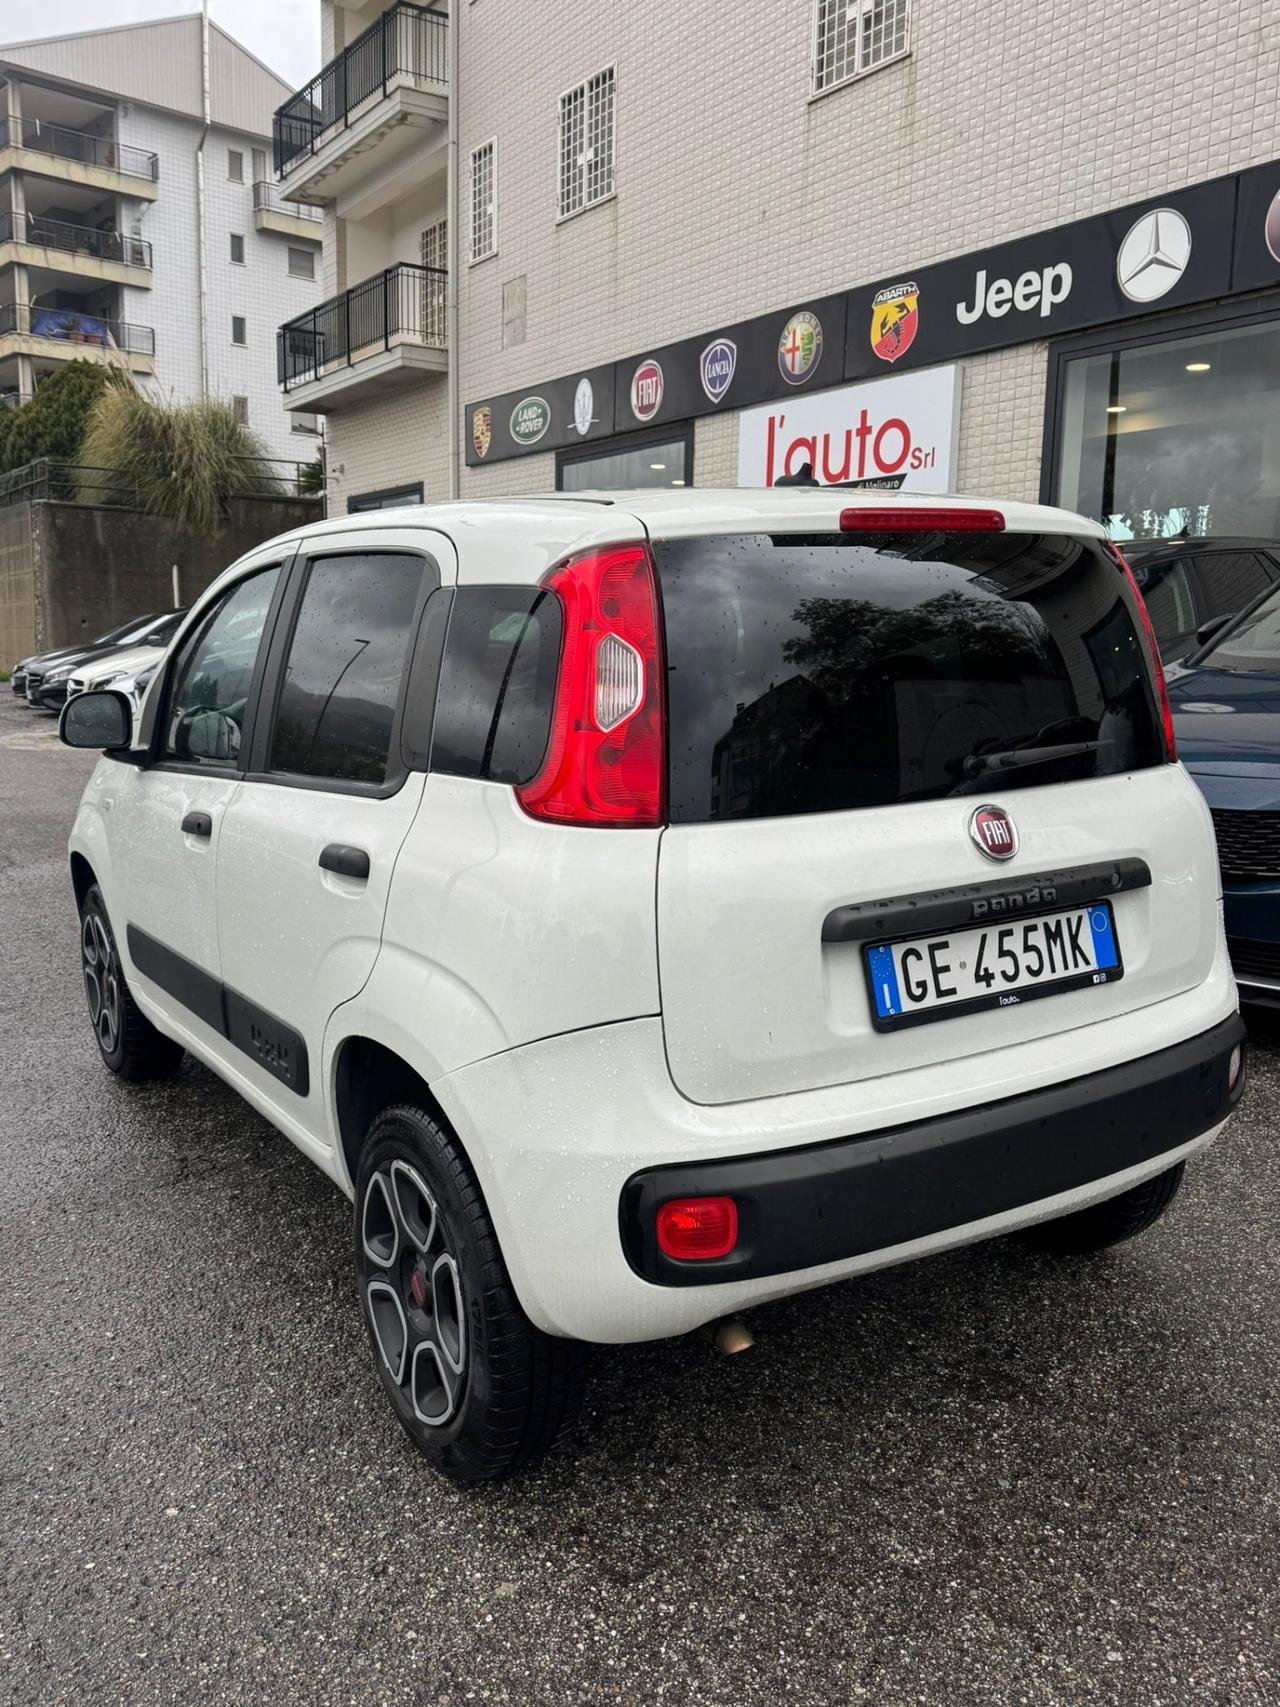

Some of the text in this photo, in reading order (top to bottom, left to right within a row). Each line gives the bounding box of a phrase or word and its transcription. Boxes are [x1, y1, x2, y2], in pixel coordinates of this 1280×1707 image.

[876, 285, 916, 303] ABARTH
[955, 262, 1073, 326] Jeep
[708, 359, 729, 379] LANCIA
[636, 376, 658, 408] FIAT
[518, 406, 537, 422] LAND
[519, 417, 544, 434] ROVER
[766, 409, 936, 488] l'auto Srl
[982, 819, 1012, 846] FIAT
[972, 886, 1057, 917] panda
[900, 939, 958, 1003] GE
[973, 914, 1092, 988] 455MK
